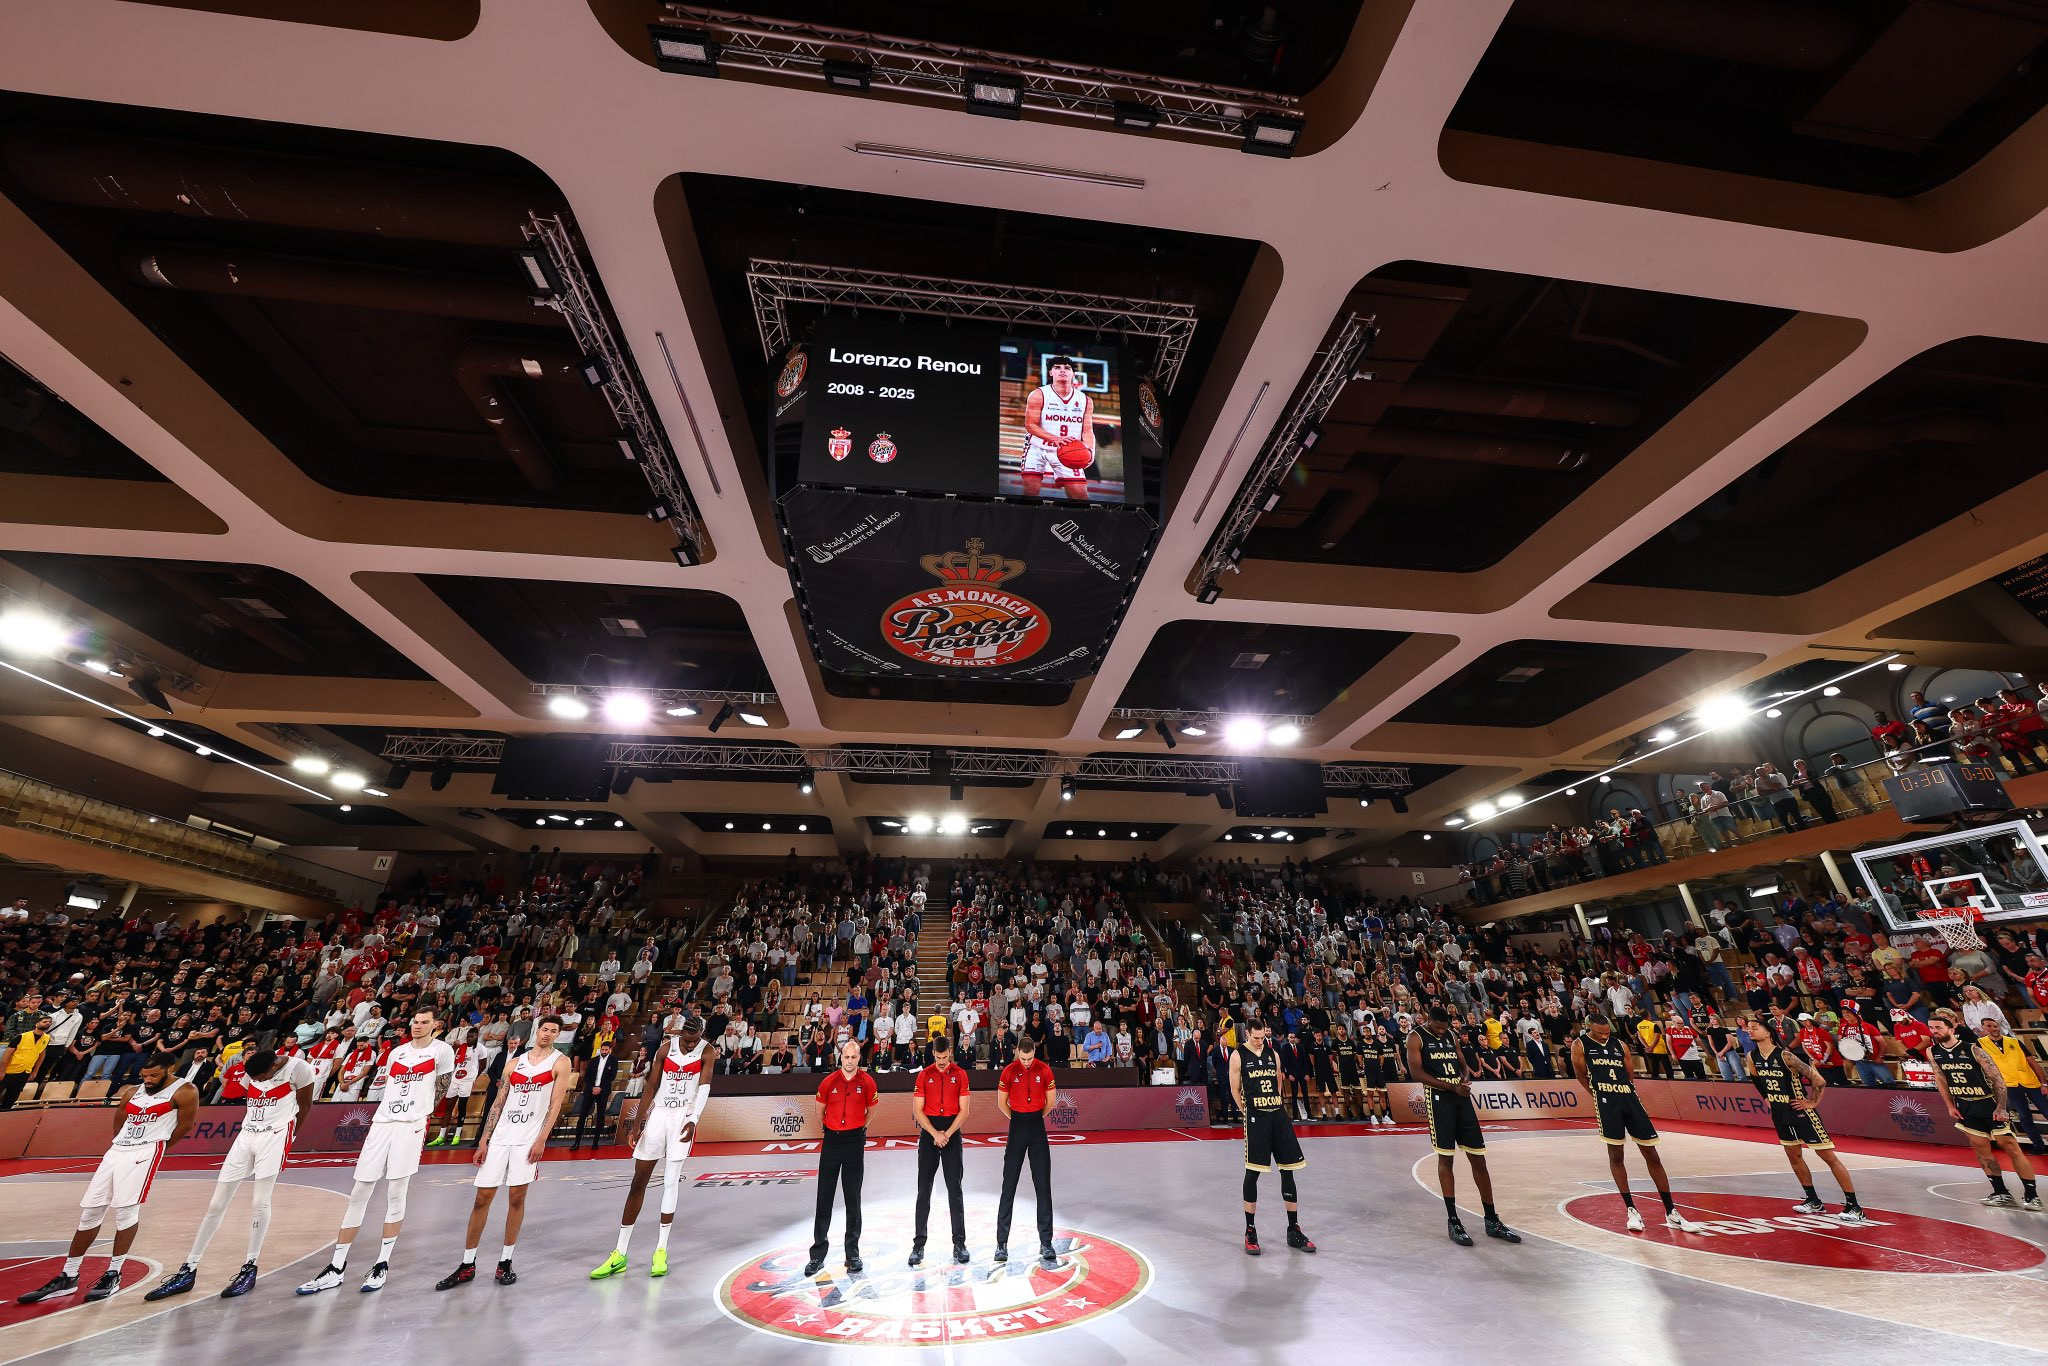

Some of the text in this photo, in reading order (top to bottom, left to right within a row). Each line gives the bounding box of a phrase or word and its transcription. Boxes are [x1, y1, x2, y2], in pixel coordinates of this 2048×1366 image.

[829, 348, 981, 375] Lorenzo Renou
[827, 382, 864, 396] 2008
[879, 386, 915, 400] 2025
[1045, 413, 1083, 424] MONACO
[1059, 425, 1069, 437] 9
[866, 529, 876, 537] DE
[874, 511, 901, 531] MONACO
[822, 514, 879, 551] Stade Louis II
[1074, 534, 1120, 571] Stade Louis II
[889, 606, 1039, 641] Roca
[927, 655, 997, 666] BASKET
[1961, 767, 1995, 781] 0:30
[1900, 769, 1945, 792] 0:30
[378, 858, 388, 868] N
[1415, 874, 1422, 883] S
[1430, 1052, 1458, 1060] MONACO
[1442, 1062, 1456, 1075] 14
[1592, 1058, 1624, 1068] MONACO
[394, 1072, 423, 1084] BOURG
[667, 1071, 693, 1081] BOURG
[1248, 1068, 1277, 1079] MONACO
[1608, 1069, 1618, 1080] 4
[1951, 1072, 1968, 1084] 55
[400, 1085, 410, 1096] 3
[514, 1083, 542, 1092] BOURG
[670, 1082, 686, 1094] 34
[1260, 1079, 1274, 1093] 22
[1598, 1082, 1632, 1094] FEDCOM
[1765, 1079, 1781, 1091] 32
[1950, 1087, 1985, 1096] FEDCOM
[248, 1097, 277, 1107] BOURG
[664, 1100, 685, 1108] YOU
[1253, 1096, 1282, 1107] FEDCOM
[1471, 1091, 1578, 1110] VIERA RADIO
[1767, 1093, 1790, 1104] DCOM
[1175, 1105, 1205, 1113] RIVIERA
[1408, 1101, 1427, 1109] RIVIE
[1696, 1095, 1772, 1116] RIVIER
[127, 1113, 157, 1123] BOURG
[251, 1108, 265, 1122] 11
[1047, 1108, 1079, 1117] RIVIERA
[1179, 1113, 1203, 1121] RADIO
[508, 1113, 530, 1124] YOU
[770, 1116, 805, 1124] RIVIERA
[1892, 1114, 1935, 1125] RIVIERA
[124, 1125, 146, 1138] 30
[335, 1126, 371, 1135] RIVIERA
[773, 1124, 801, 1133] RADIO
[1900, 1122, 1936, 1134] RADIO
[335, 1133, 364, 1142] RADIO
[760, 1133, 1088, 1153] MNACO
[692, 1178, 804, 1188] ELITE
[823, 1306, 1056, 1339] BASKET
